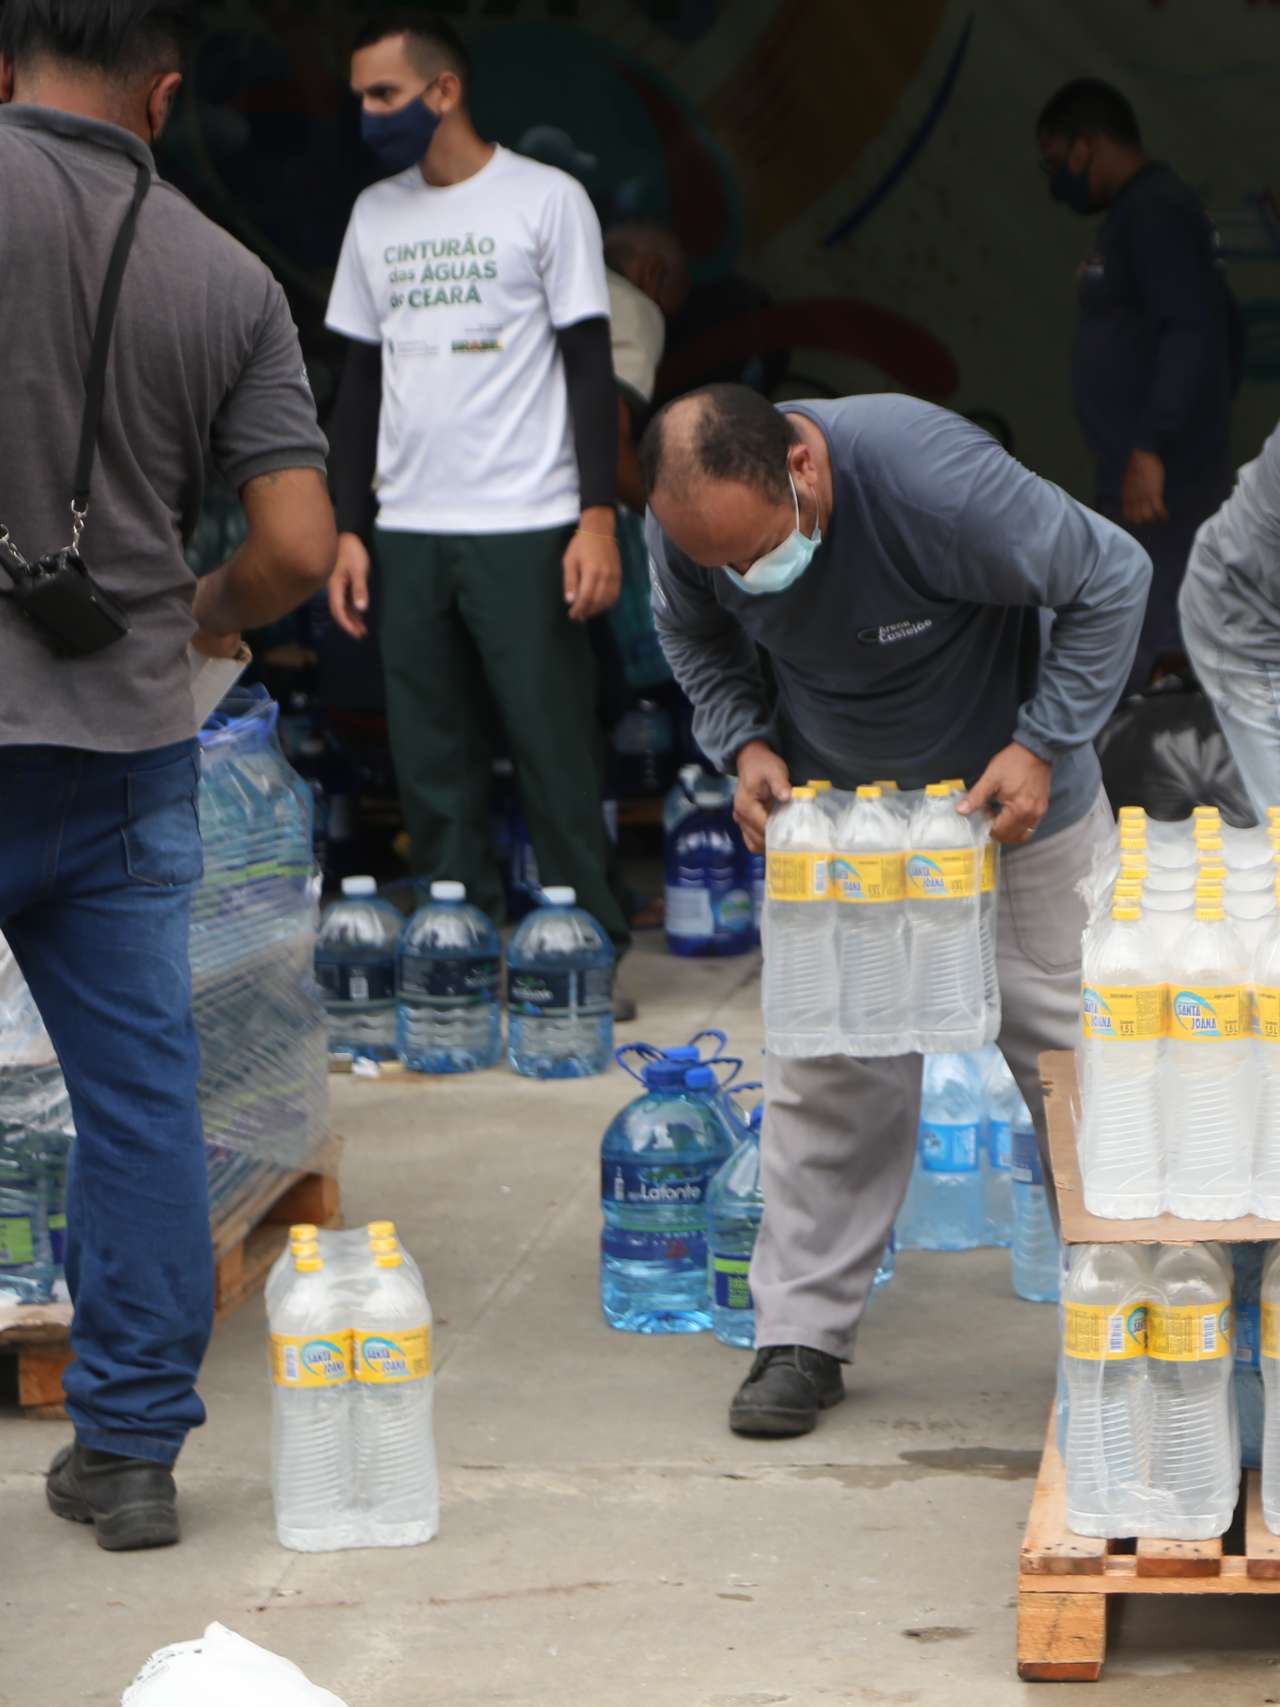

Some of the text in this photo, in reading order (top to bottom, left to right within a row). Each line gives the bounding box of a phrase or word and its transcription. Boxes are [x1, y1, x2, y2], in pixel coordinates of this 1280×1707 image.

[384, 232, 495, 264] CINTURÃO
[389, 258, 497, 283] das ÁGUAS
[408, 279, 482, 308] CEARÁ
[1178, 1005, 1200, 1016] SANTA
[1192, 1018, 1216, 1029] JOANA
